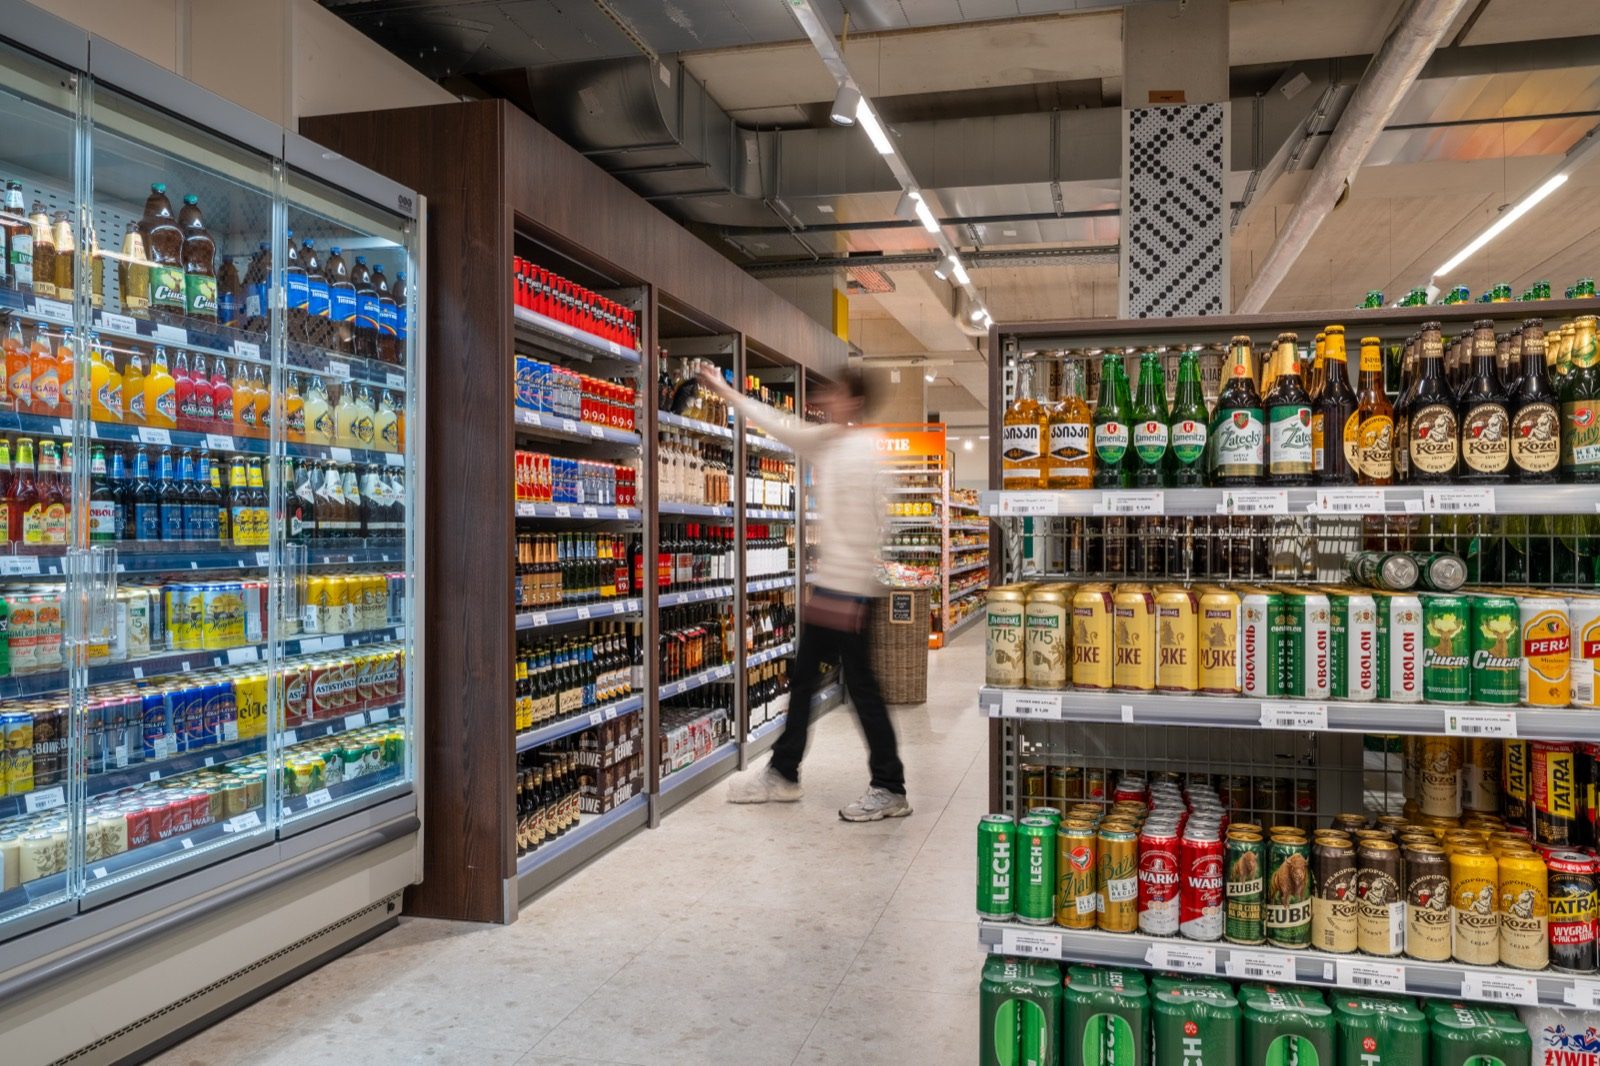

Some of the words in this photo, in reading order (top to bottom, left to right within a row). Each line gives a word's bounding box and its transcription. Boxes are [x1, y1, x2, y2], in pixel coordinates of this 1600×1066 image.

[155, 286, 186, 302] Ciuca
[583, 409, 589, 420] 9
[592, 411, 598, 421] 9
[600, 413, 606, 423] 9
[612, 415, 617, 425] 9
[619, 417, 625, 427] 9
[627, 419, 633, 429] 9
[1109, 423, 1116, 432] K
[1148, 423, 1155, 432] K
[1185, 423, 1192, 432] K
[876, 437, 910, 451] CTIE
[1416, 441, 1454, 456] Kozel
[1469, 441, 1506, 455] Kozel
[1518, 440, 1557, 455] Kozel
[1363, 450, 1392, 462] Koze
[991, 629, 1016, 643] 1715
[1028, 630, 1053, 645] 1715
[1530, 638, 1569, 653] PERŁA
[1074, 646, 1101, 666] ЯКЕ
[1116, 647, 1142, 667] ЯКЕ
[1160, 648, 1187, 667] ЯКЕ
[1245, 625, 1256, 691] ОБОЛОНЬ
[1317, 630, 1327, 688] OBOLON
[1360, 631, 1371, 690] OBOLON
[1403, 632, 1414, 691] OBOLON
[1509, 743, 1523, 794] TATRA
[1554, 759, 1570, 813] TATRA
[992, 842, 1010, 901] LECH
[1030, 846, 1043, 883] LECH
[1138, 870, 1179, 885] WARKA
[1188, 876, 1223, 890] WARK
[1332, 903, 1357, 918] Koz
[1358, 902, 1389, 917] Koze
[1549, 893, 1596, 915] TATRA
[1459, 912, 1497, 928] Kozel
[1501, 914, 1542, 931] Kozel
[1544, 1049, 1600, 1066] ŻYWIE
